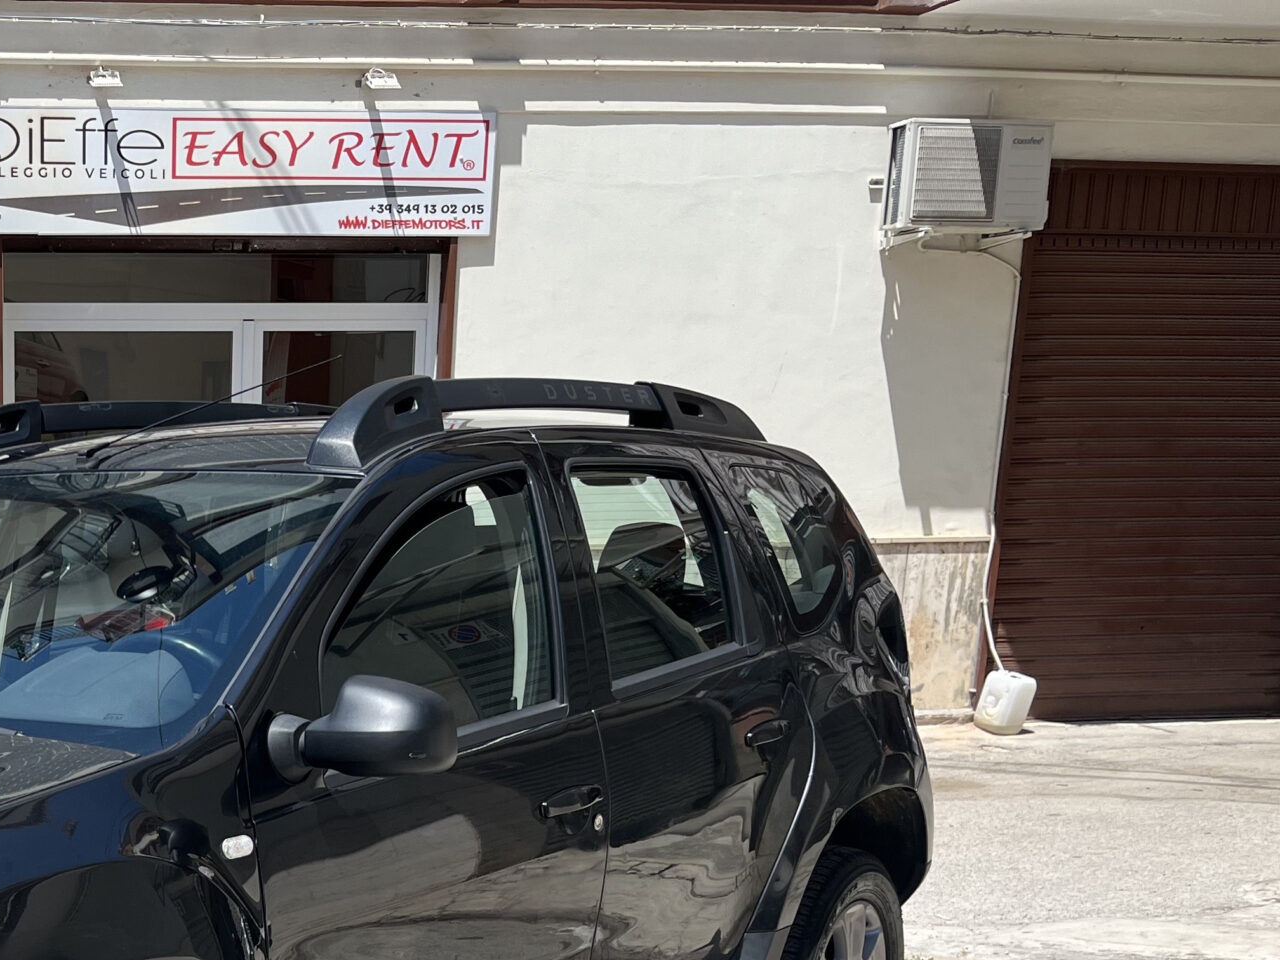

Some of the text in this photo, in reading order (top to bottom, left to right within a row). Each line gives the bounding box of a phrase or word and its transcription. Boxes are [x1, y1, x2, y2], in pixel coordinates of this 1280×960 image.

[183, 129, 315, 169] EASY
[85, 168, 166, 180] VEICOLI
[370, 203, 484, 214] +39 349 13 02 015
[338, 215, 484, 230] WWW.DIEFFEMOTORS.IT
[543, 383, 652, 405] DUSTER
